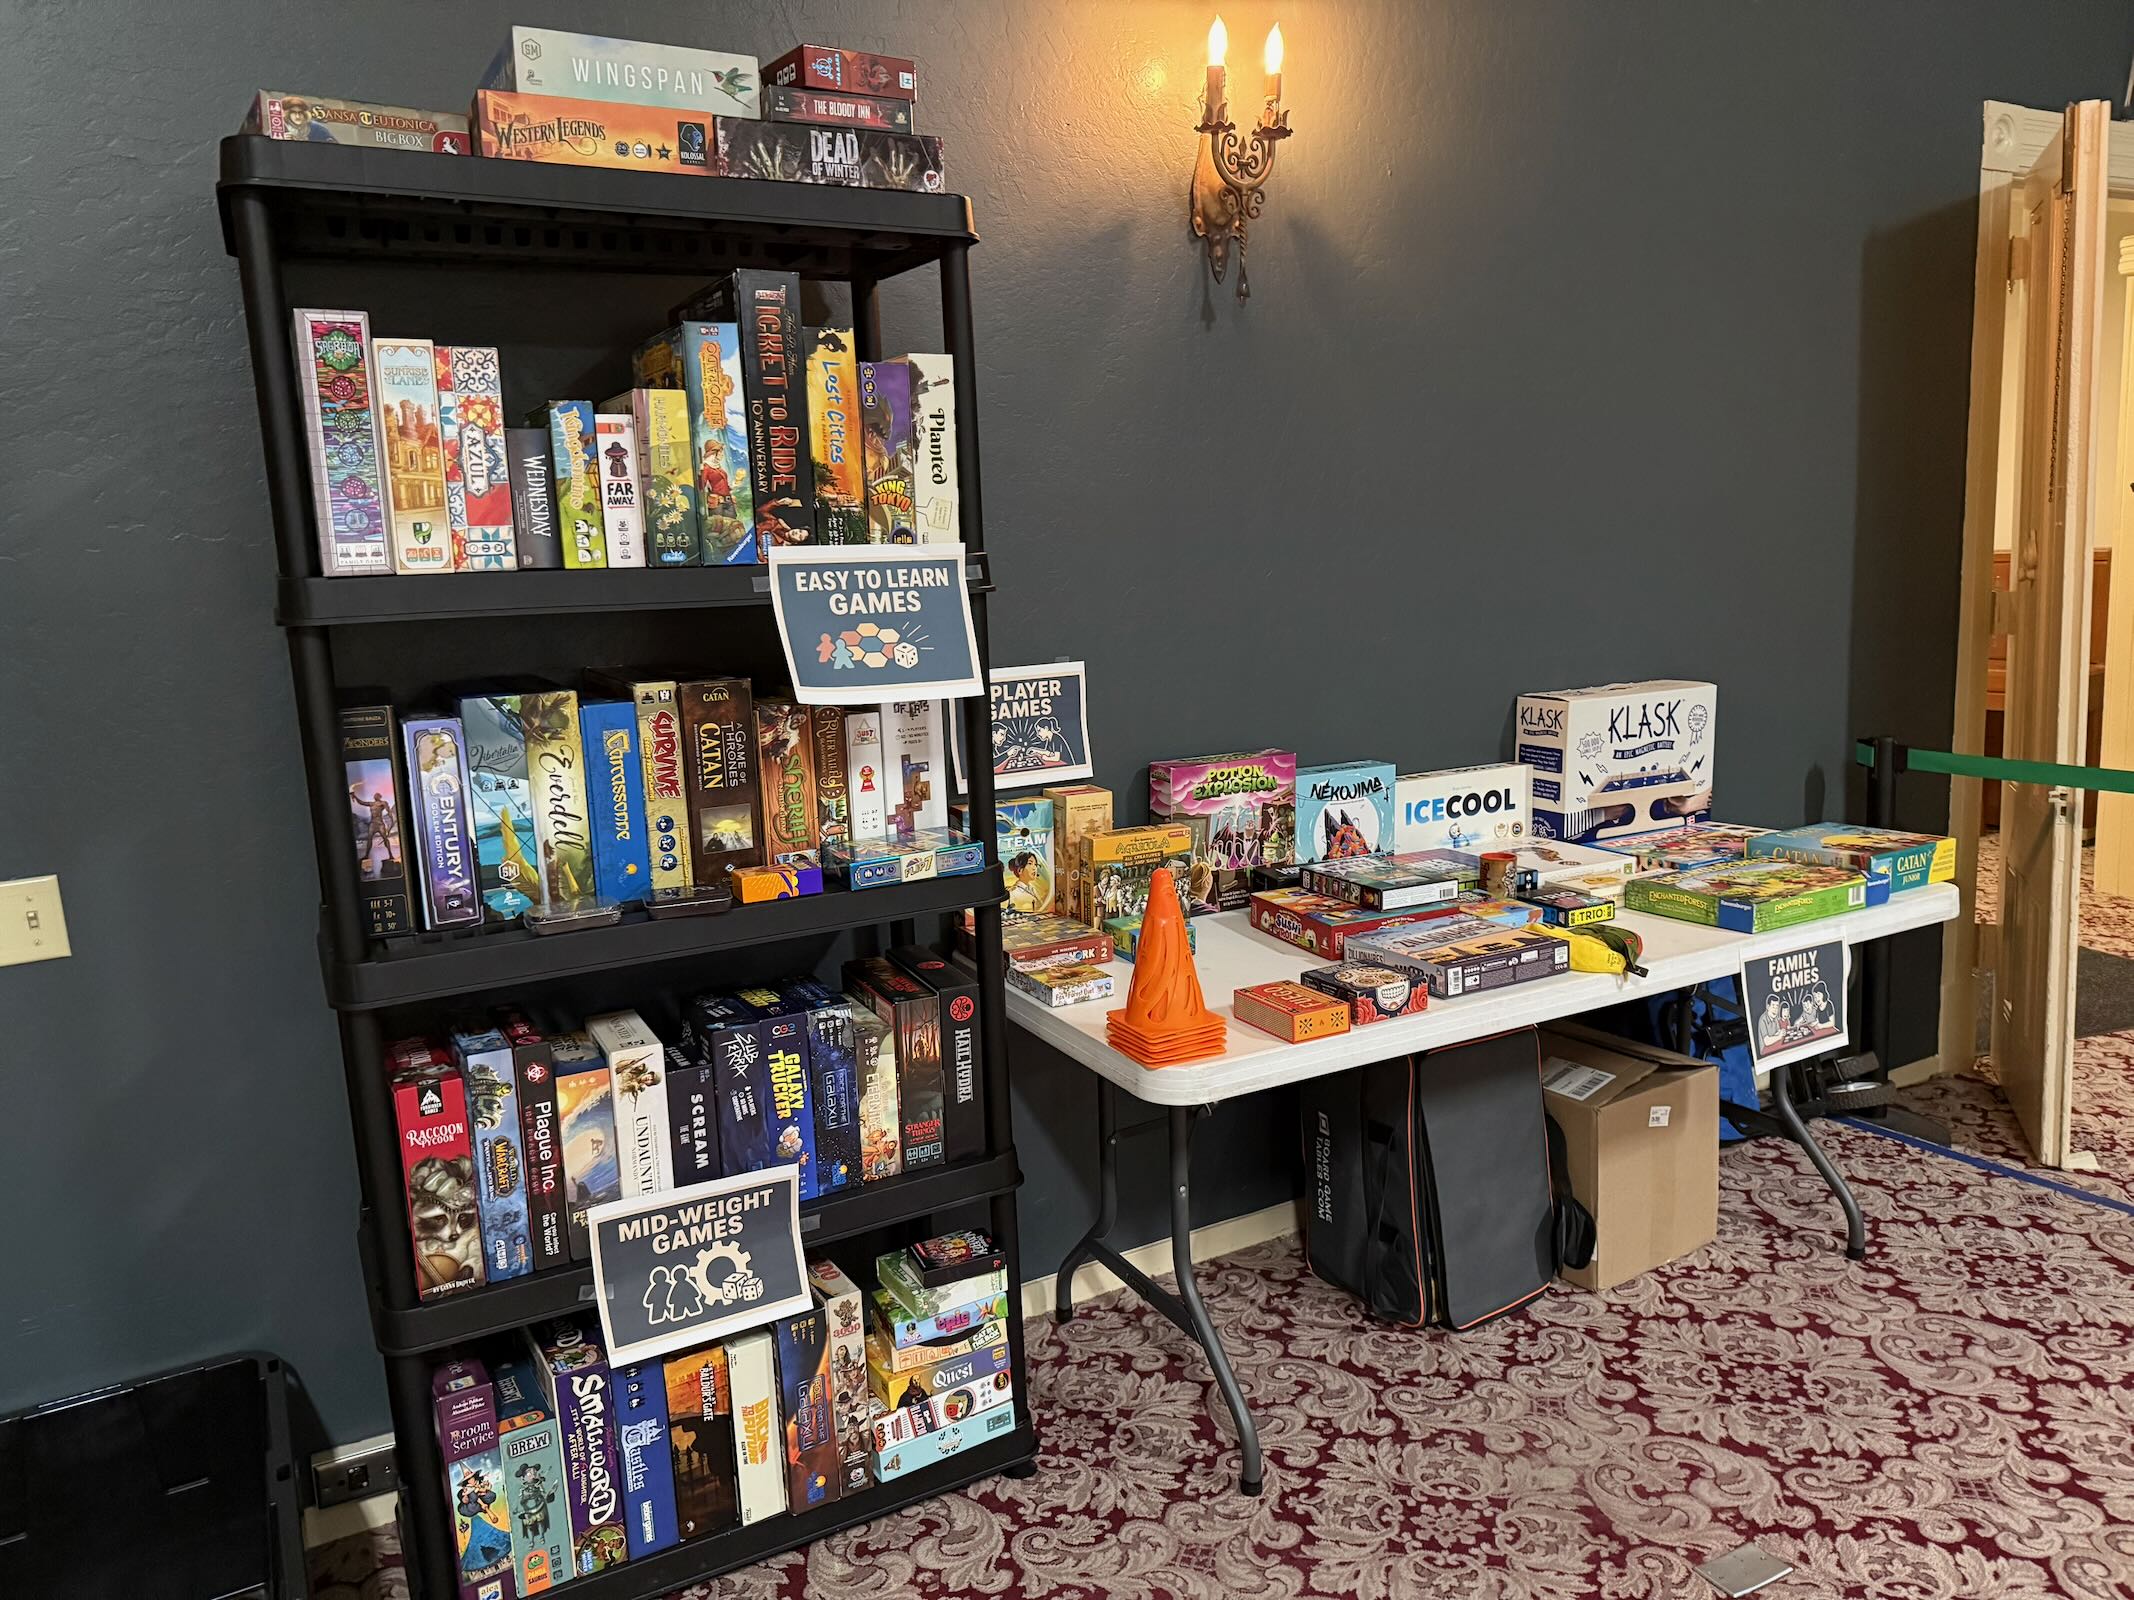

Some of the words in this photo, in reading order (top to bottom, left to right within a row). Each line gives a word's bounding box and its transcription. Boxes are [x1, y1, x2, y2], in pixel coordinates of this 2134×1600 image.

[571, 56, 703, 96] WINGSPAN
[309, 105, 358, 123] HANSA
[358, 111, 437, 134] TEUTONICA
[813, 99, 827, 115] THE
[828, 101, 856, 118] BLOODY
[857, 104, 871, 120] INN
[375, 131, 397, 145] BIG
[398, 133, 424, 148] BOX
[494, 122, 556, 149] WESTERN
[555, 117, 606, 142] LEGENDS
[810, 129, 859, 164] DEAD
[680, 151, 705, 161] KOLOSSAL
[812, 163, 823, 176] OF
[824, 164, 860, 180] WINTER
[755, 284, 789, 390] TICKET
[383, 367, 429, 377] SUNRISE
[705, 342, 722, 408] DORADO
[821, 360, 842, 404] Lost
[767, 395, 788, 421] TO
[826, 408, 847, 465] Cities
[929, 408, 948, 486] Planted
[466, 434, 486, 484] AZUL
[560, 406, 590, 510] Kingdomino
[754, 420, 769, 495] ANNIVERSARY
[769, 426, 800, 493] RIDE
[522, 454, 552, 537] WEDNESDAY
[607, 482, 634, 496] FAR
[607, 496, 635, 506] AWAY
[873, 481, 906, 495] KING
[871, 492, 913, 512] TOKYO
[795, 570, 849, 592] EASY
[854, 569, 881, 589] TO
[887, 567, 949, 588] LEARN
[829, 590, 922, 615] GAMES
[703, 687, 729, 702] CATAN
[991, 680, 1061, 702] PLAYER
[893, 702, 906, 714] OF
[906, 700, 930, 717] CATS
[1520, 706, 1564, 731] KLASK
[1608, 699, 1681, 744] KLASK
[816, 716, 840, 751] RIVER
[856, 730, 874, 738] JUST
[470, 743, 520, 772] Libertalia
[648, 710, 683, 800] SURVIVE
[699, 722, 724, 790] CATAN
[721, 721, 739, 788] THRONES
[735, 731, 747, 769] GAME
[738, 772, 747, 784] OF
[819, 751, 844, 789] VALLEY
[1206, 765, 1265, 782] POTION
[539, 744, 586, 850] Everdell
[604, 730, 631, 841] Carcassonne
[1193, 776, 1278, 800] EXPLOSION
[431, 803, 440, 834] GOLEM
[1405, 788, 1516, 826] ICECOOL
[430, 773, 464, 880] CENTURY
[434, 835, 444, 869] EDITION
[1006, 833, 1048, 848] TEAM
[1115, 837, 1171, 855] AGRICOLA
[502, 866, 517, 877] SM
[904, 862, 925, 879] FLIP
[924, 854, 933, 872] 7
[1897, 852, 1928, 872] CATAN
[1902, 874, 1921, 885] JUNIOR
[1649, 890, 1684, 903] ENCHANTED
[1683, 895, 1708, 910] FOREST
[1275, 913, 1302, 935] SUSHI
[1579, 908, 1604, 921] TRIO
[1101, 947, 1108, 958] 2
[1768, 950, 1818, 977] FAMILY
[1772, 967, 1820, 993] GAMES
[720, 1034, 748, 1080] TERRA
[735, 1033, 760, 1064] SUB
[955, 1028, 972, 1060] HAIL
[768, 1050, 792, 1120] TRUCKER
[784, 1053, 804, 1109] GALAXY
[956, 1060, 973, 1104] HYDRA
[406, 1122, 464, 1147] RACCOON
[534, 1101, 552, 1161] Plague
[690, 1093, 709, 1170] SCREAM
[905, 1119, 941, 1134] STRANGER
[421, 1134, 455, 1148] TYCOON
[495, 1141, 510, 1189] WARCRAFT
[635, 1115, 655, 1196] UNDAUNTE
[1322, 1138, 1331, 1182] BOARD
[541, 1163, 557, 1194] Inc.
[618, 1189, 774, 1243] MID-WEIGHT
[1324, 1184, 1333, 1224] GAME
[542, 1214, 550, 1227] the
[544, 1228, 553, 1256] World?
[652, 1215, 744, 1255] GAMES
[972, 1331, 986, 1342] CAT
[985, 1330, 1000, 1344] BOX
[932, 1362, 974, 1388] Quest
[703, 1403, 714, 1422] GATE
[754, 1397, 770, 1442] BACK
[450, 1421, 491, 1442] Broom
[453, 1431, 495, 1454] Service
[511, 1433, 549, 1457] BREW
[576, 1428, 585, 1451] WORLD
[743, 1416, 759, 1464] FUTURE
[567, 1433, 578, 1460] AFTER
[579, 1452, 587, 1460] OF
[625, 1428, 649, 1491] Castles
[481, 1584, 499, 1595] alea
